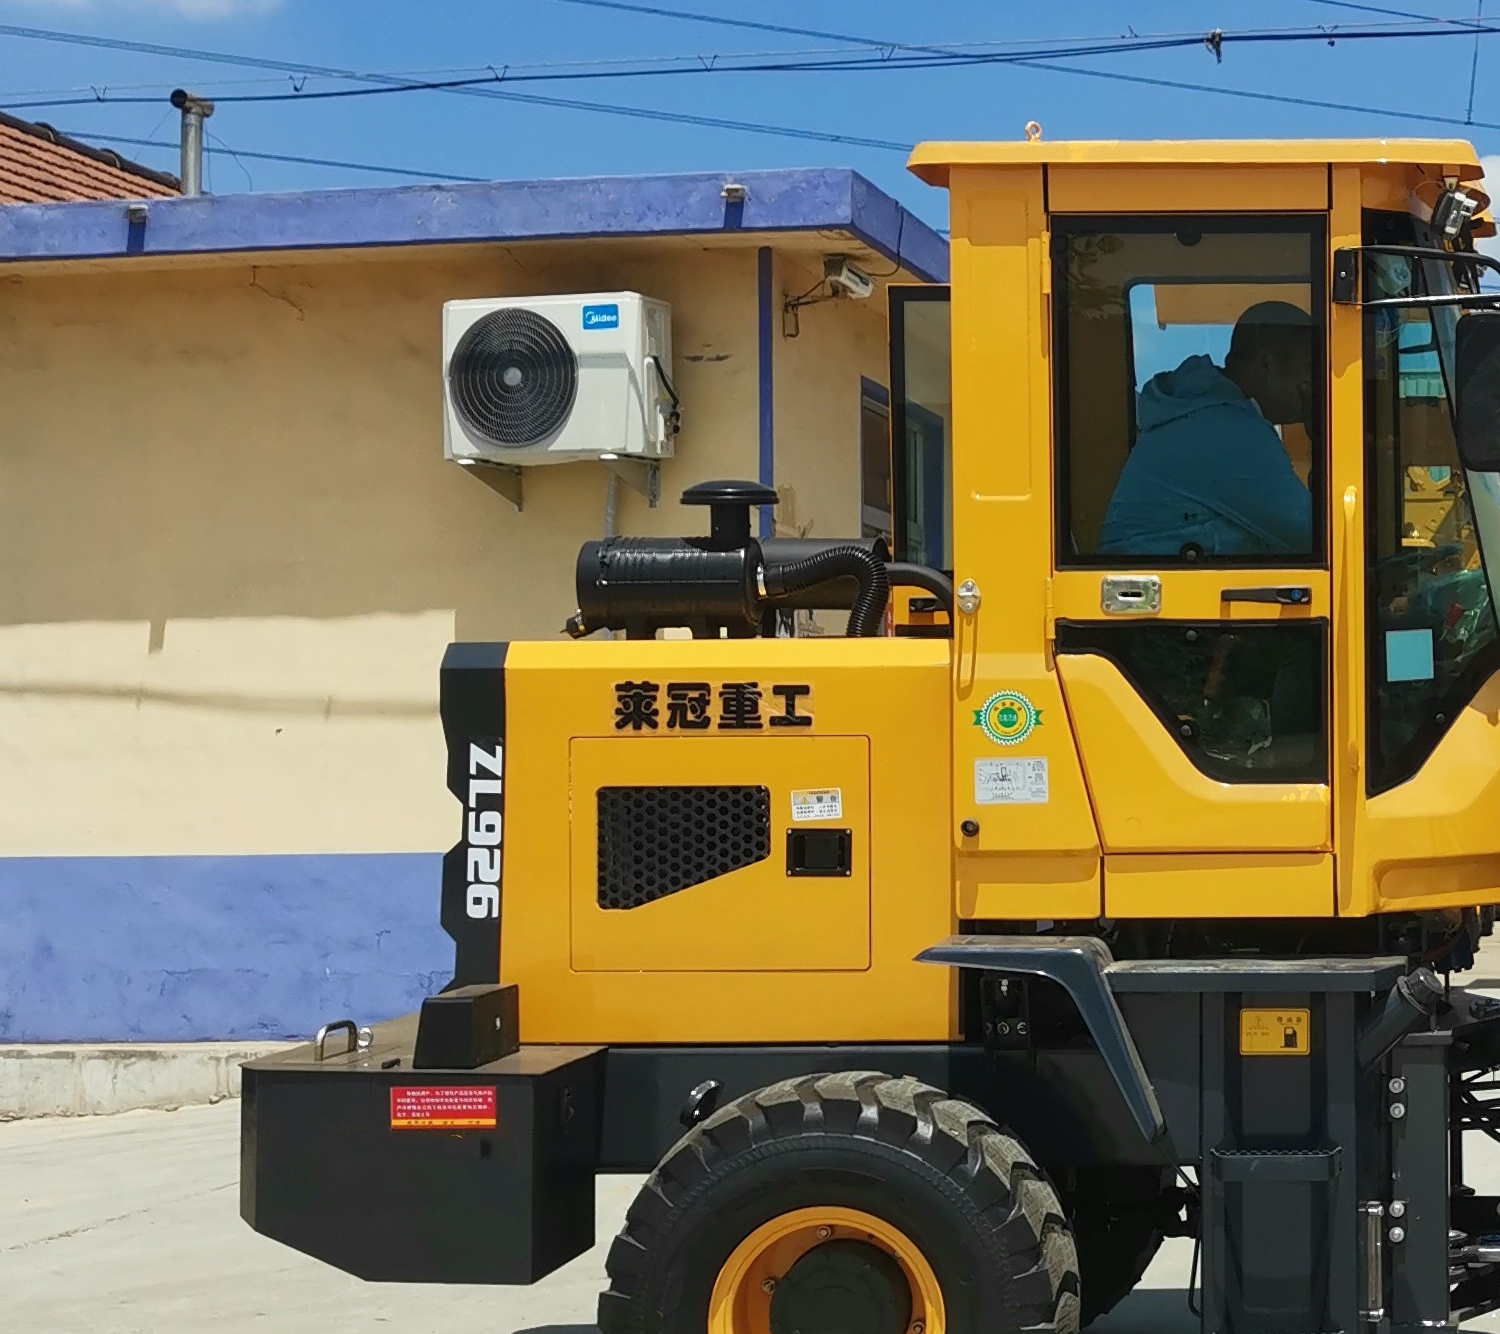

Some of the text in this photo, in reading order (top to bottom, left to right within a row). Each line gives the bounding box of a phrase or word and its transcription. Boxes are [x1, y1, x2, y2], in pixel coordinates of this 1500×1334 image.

[615, 681, 813, 731] 莱冠重工
[466, 743, 503, 919] ZL926
